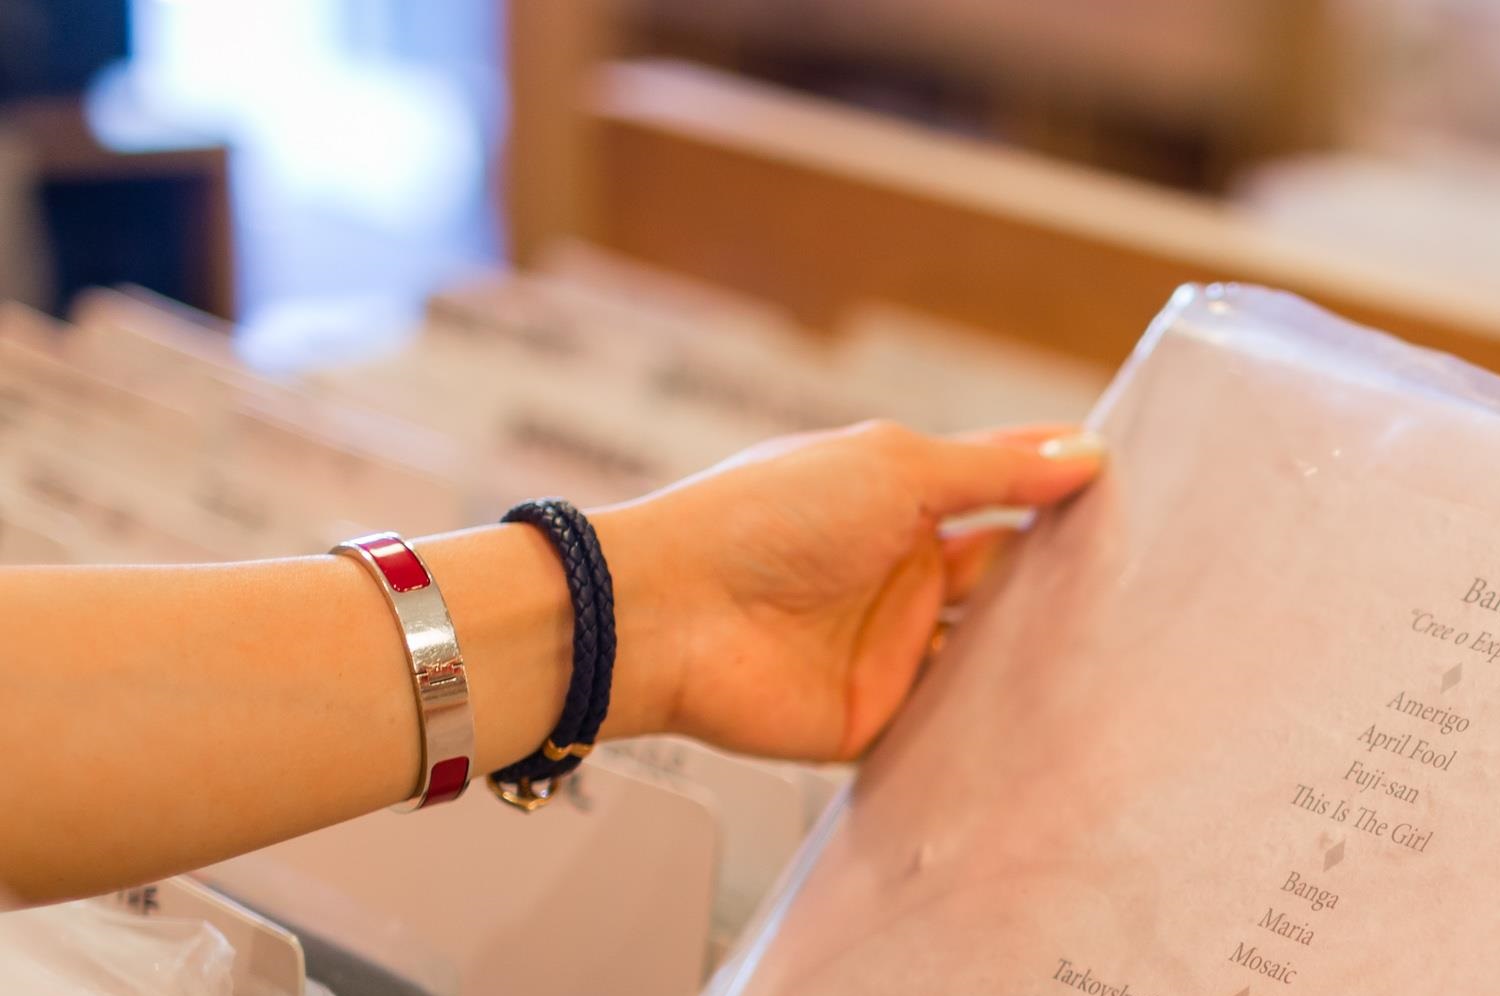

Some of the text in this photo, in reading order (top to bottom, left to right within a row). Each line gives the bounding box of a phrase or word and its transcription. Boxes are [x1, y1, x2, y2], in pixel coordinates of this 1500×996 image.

[1454, 631, 1470, 645] o
[1385, 690, 1470, 735] Amerigo
[1357, 724, 1458, 771] April Fool
[1342, 760, 1419, 804] Fuji-san
[1290, 783, 1434, 853] This Is The Girl
[1280, 870, 1340, 911] Banga
[1257, 907, 1315, 946] Maria
[1228, 941, 1298, 985] Mosaic
